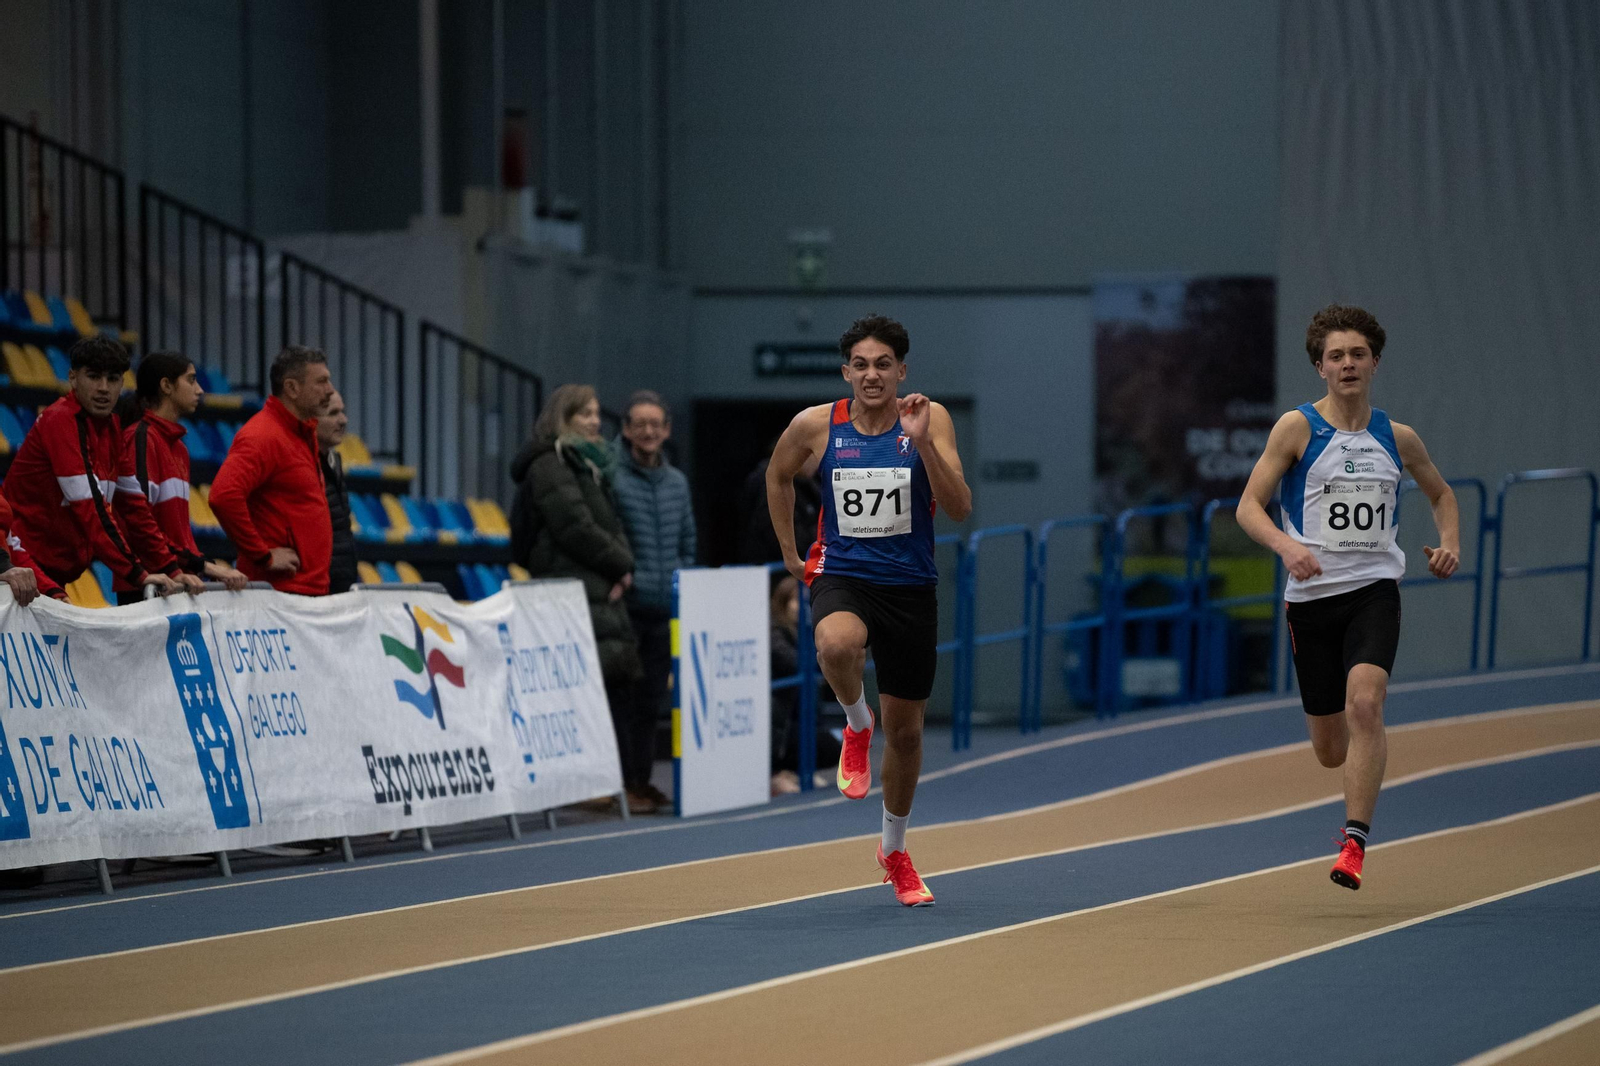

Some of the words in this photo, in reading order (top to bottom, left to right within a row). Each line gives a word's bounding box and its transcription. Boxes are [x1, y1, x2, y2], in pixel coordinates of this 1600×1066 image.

[843, 488, 901, 517] 871
[1328, 502, 1386, 531] 801
[853, 525, 895, 534] atletismo.gal
[1338, 540, 1379, 549] atletismo.gal
[0, 632, 87, 709] XUNTA
[225, 628, 296, 674] DEPORTE
[247, 691, 307, 739] GALEGO
[19, 735, 72, 814] DE
[69, 733, 165, 812] GALICIA
[361, 744, 495, 815] Expourense
